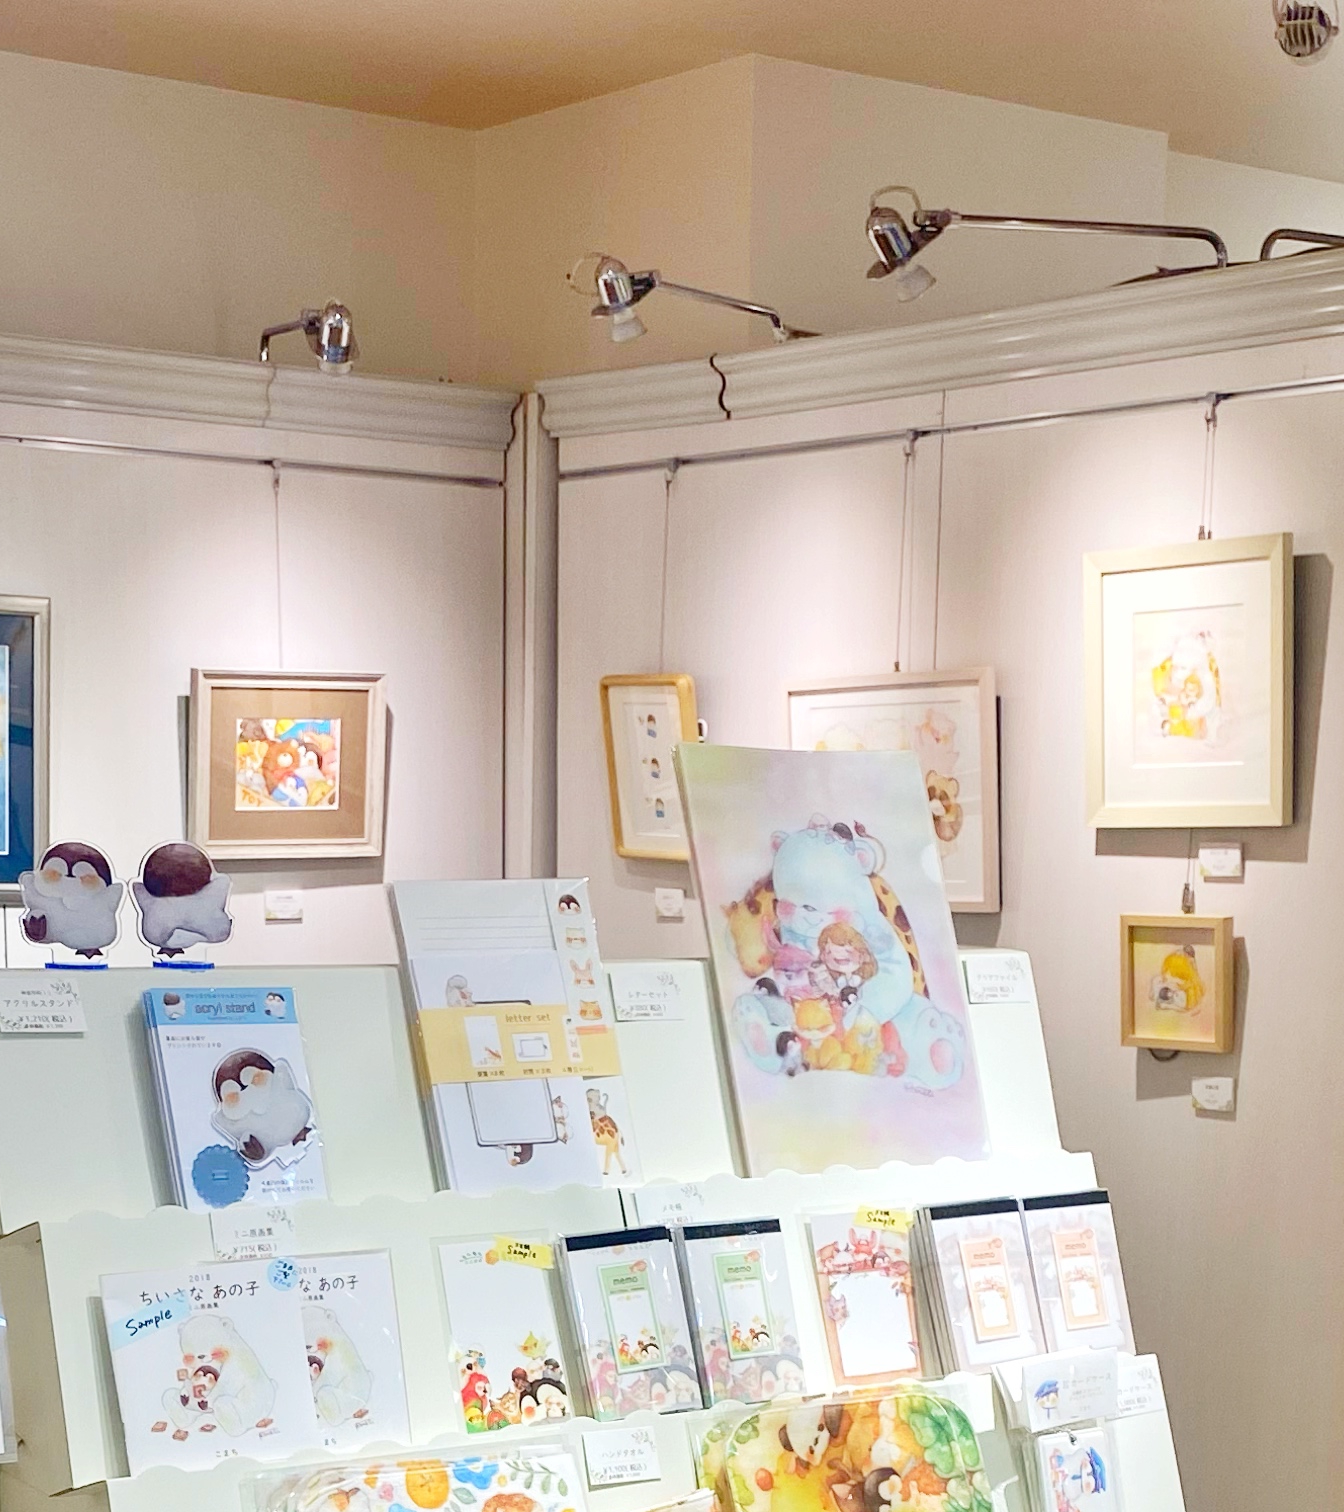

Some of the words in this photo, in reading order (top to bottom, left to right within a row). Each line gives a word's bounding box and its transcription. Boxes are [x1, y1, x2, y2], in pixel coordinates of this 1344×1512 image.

[505, 1013, 534, 1024] letter
[536, 1012, 552, 1022] set
[866, 1211, 896, 1227] Sample
[233, 1227, 274, 1238] ミニ原画集
[727, 1265, 752, 1274] memo
[189, 1274, 211, 1282] 2018
[319, 1275, 359, 1291] あの子
[613, 1275, 638, 1286] memo
[139, 1286, 204, 1306] ちいさな
[213, 1280, 260, 1299] あの子
[126, 1308, 173, 1337] Sample
